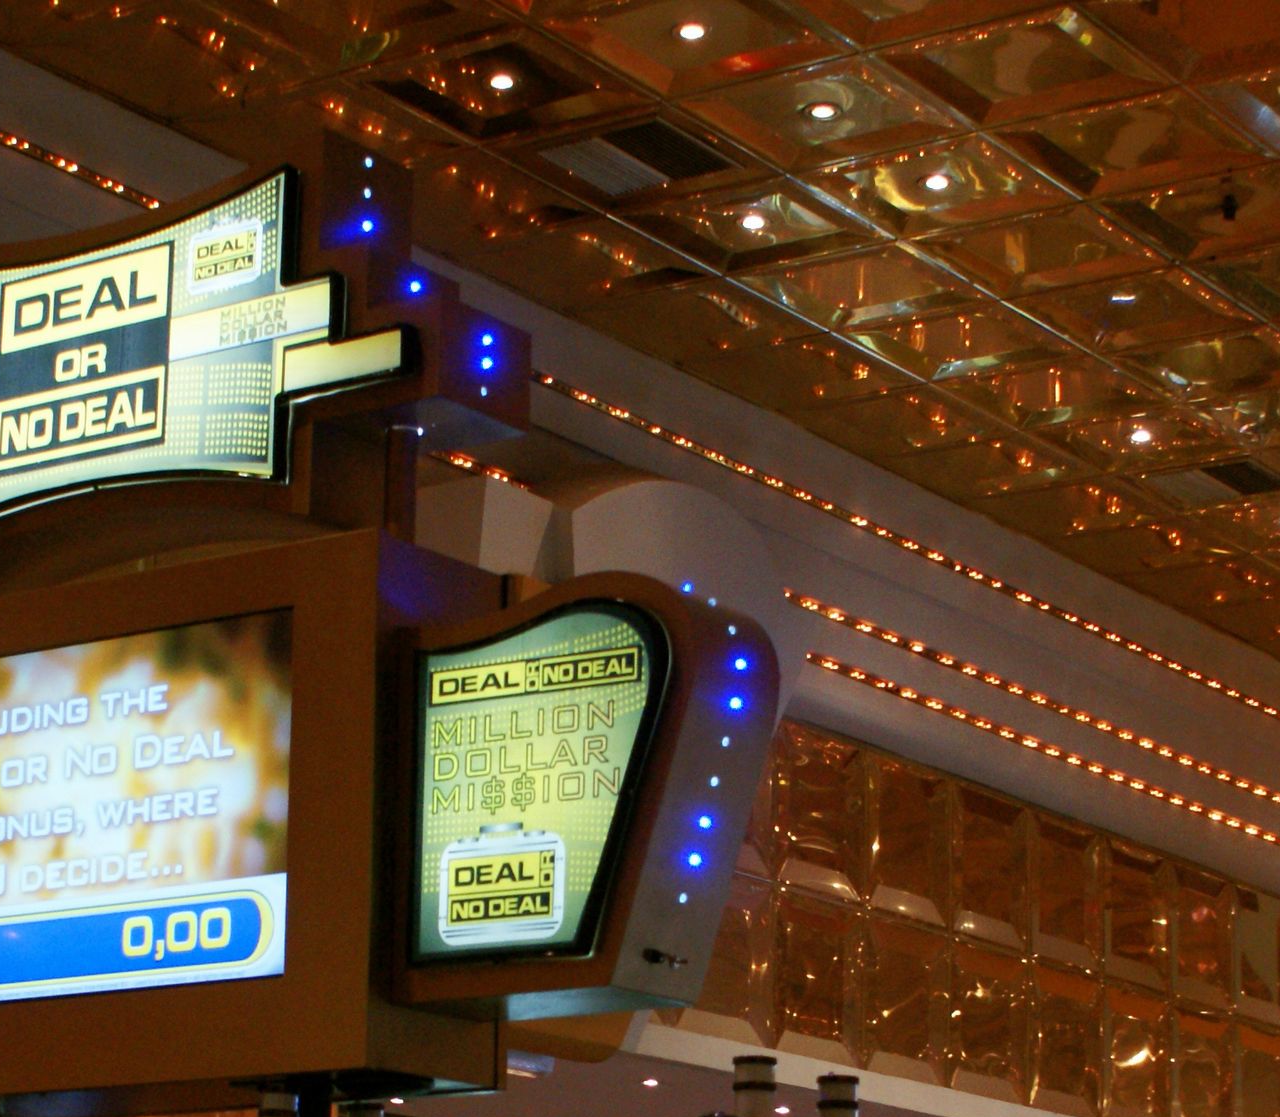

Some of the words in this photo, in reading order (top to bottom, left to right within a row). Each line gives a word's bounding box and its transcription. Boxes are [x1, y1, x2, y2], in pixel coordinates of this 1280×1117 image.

[194, 238, 245, 261] DEAL
[194, 262, 215, 281] NO
[216, 254, 254, 276] DEAL
[13, 269, 158, 336] DEAL
[220, 295, 286, 320] MILLION
[220, 310, 284, 334] DOLLAR
[54, 342, 107, 383] OR
[0, 406, 53, 457] NO
[57, 388, 157, 445] DEAL
[439, 671, 520, 697] DEAL
[542, 661, 576, 686] NO
[577, 652, 634, 682] DEAL
[100, 684, 169, 718] THE
[433, 699, 616, 749] MILLION
[0, 755, 48, 788] OR
[64, 744, 118, 781] NO
[133, 729, 235, 770] DEAL
[433, 735, 609, 782] DOLLAR
[97, 788, 219, 827] WHERE
[432, 766, 620, 816] MI$$ION
[19, 851, 185, 894] DECIDE...
[454, 860, 535, 887] DEAL
[451, 899, 484, 922] NO
[487, 893, 550, 918] DEAL
[122, 906, 232, 962] 0,00
